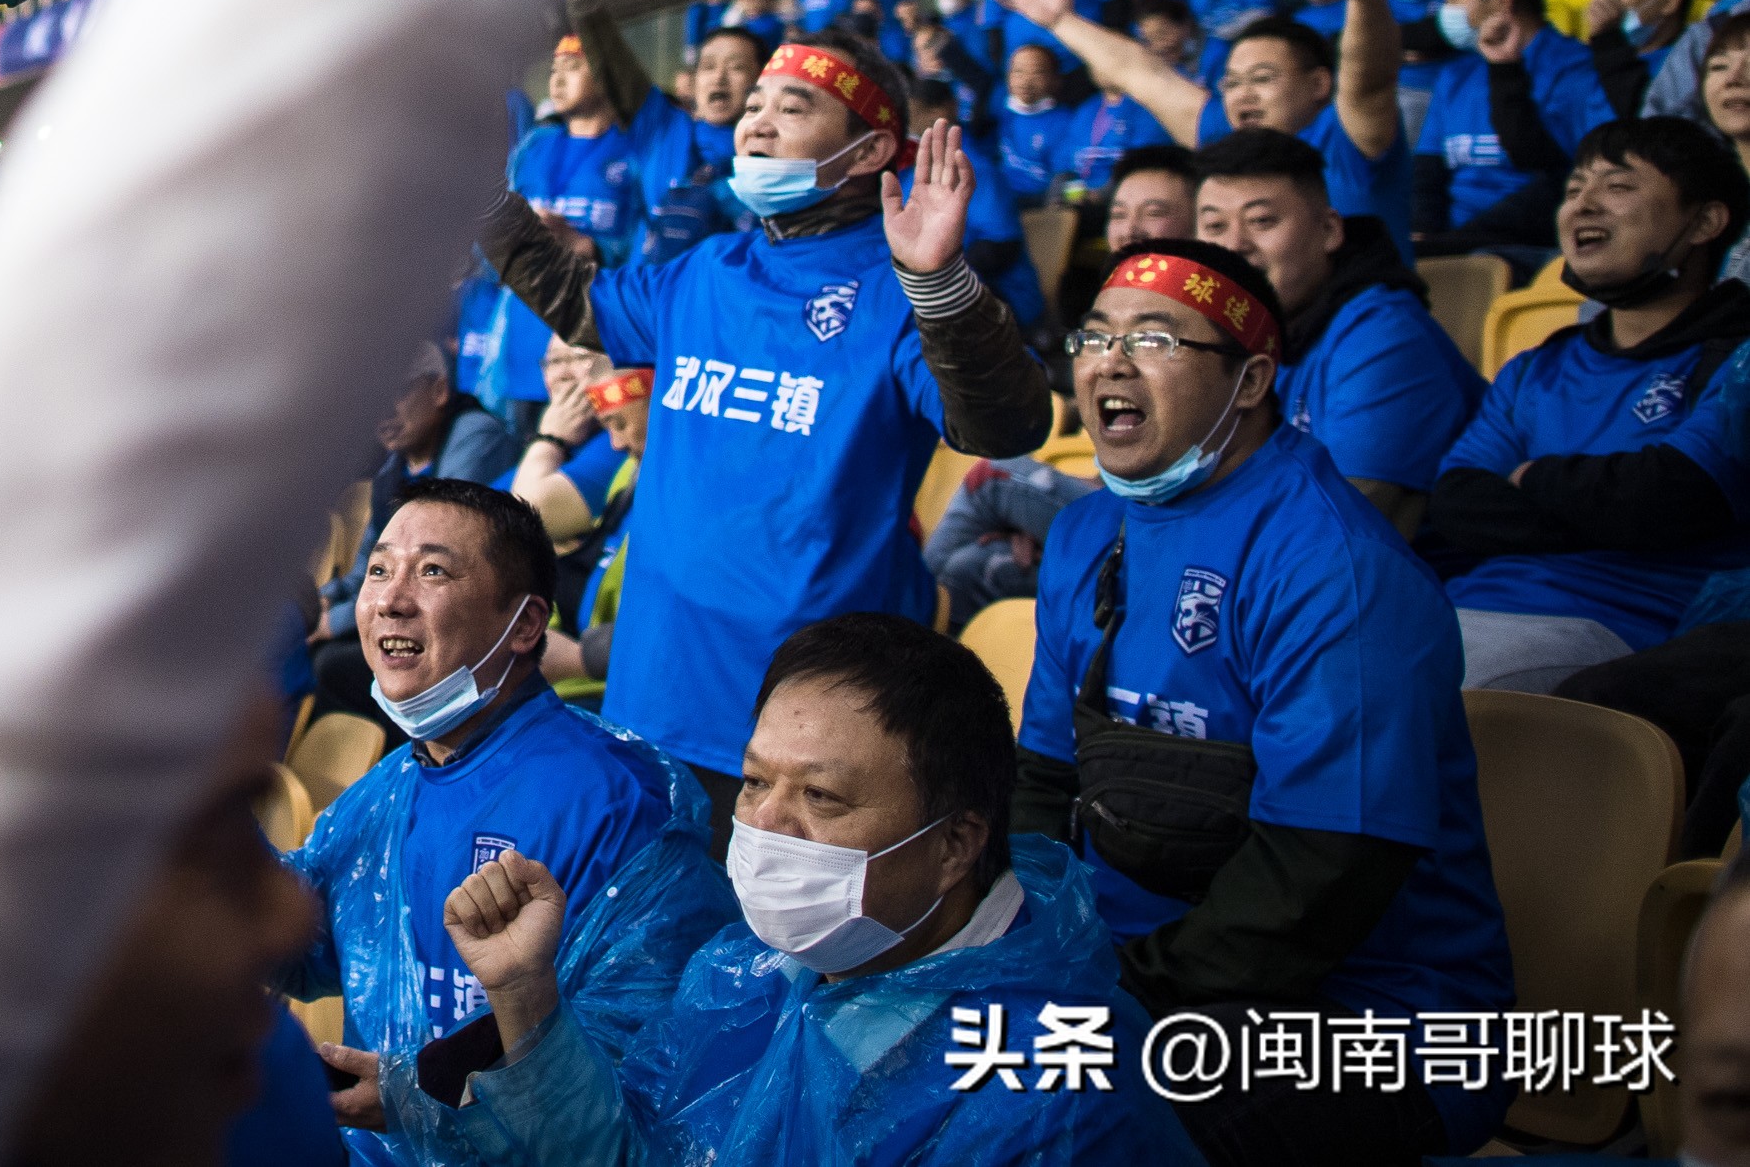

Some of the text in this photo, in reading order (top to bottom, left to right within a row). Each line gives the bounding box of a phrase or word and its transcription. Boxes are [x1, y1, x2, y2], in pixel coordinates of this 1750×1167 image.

[1182, 272, 1250, 332] 球迷
[661, 356, 825, 437] 武汉三镇
